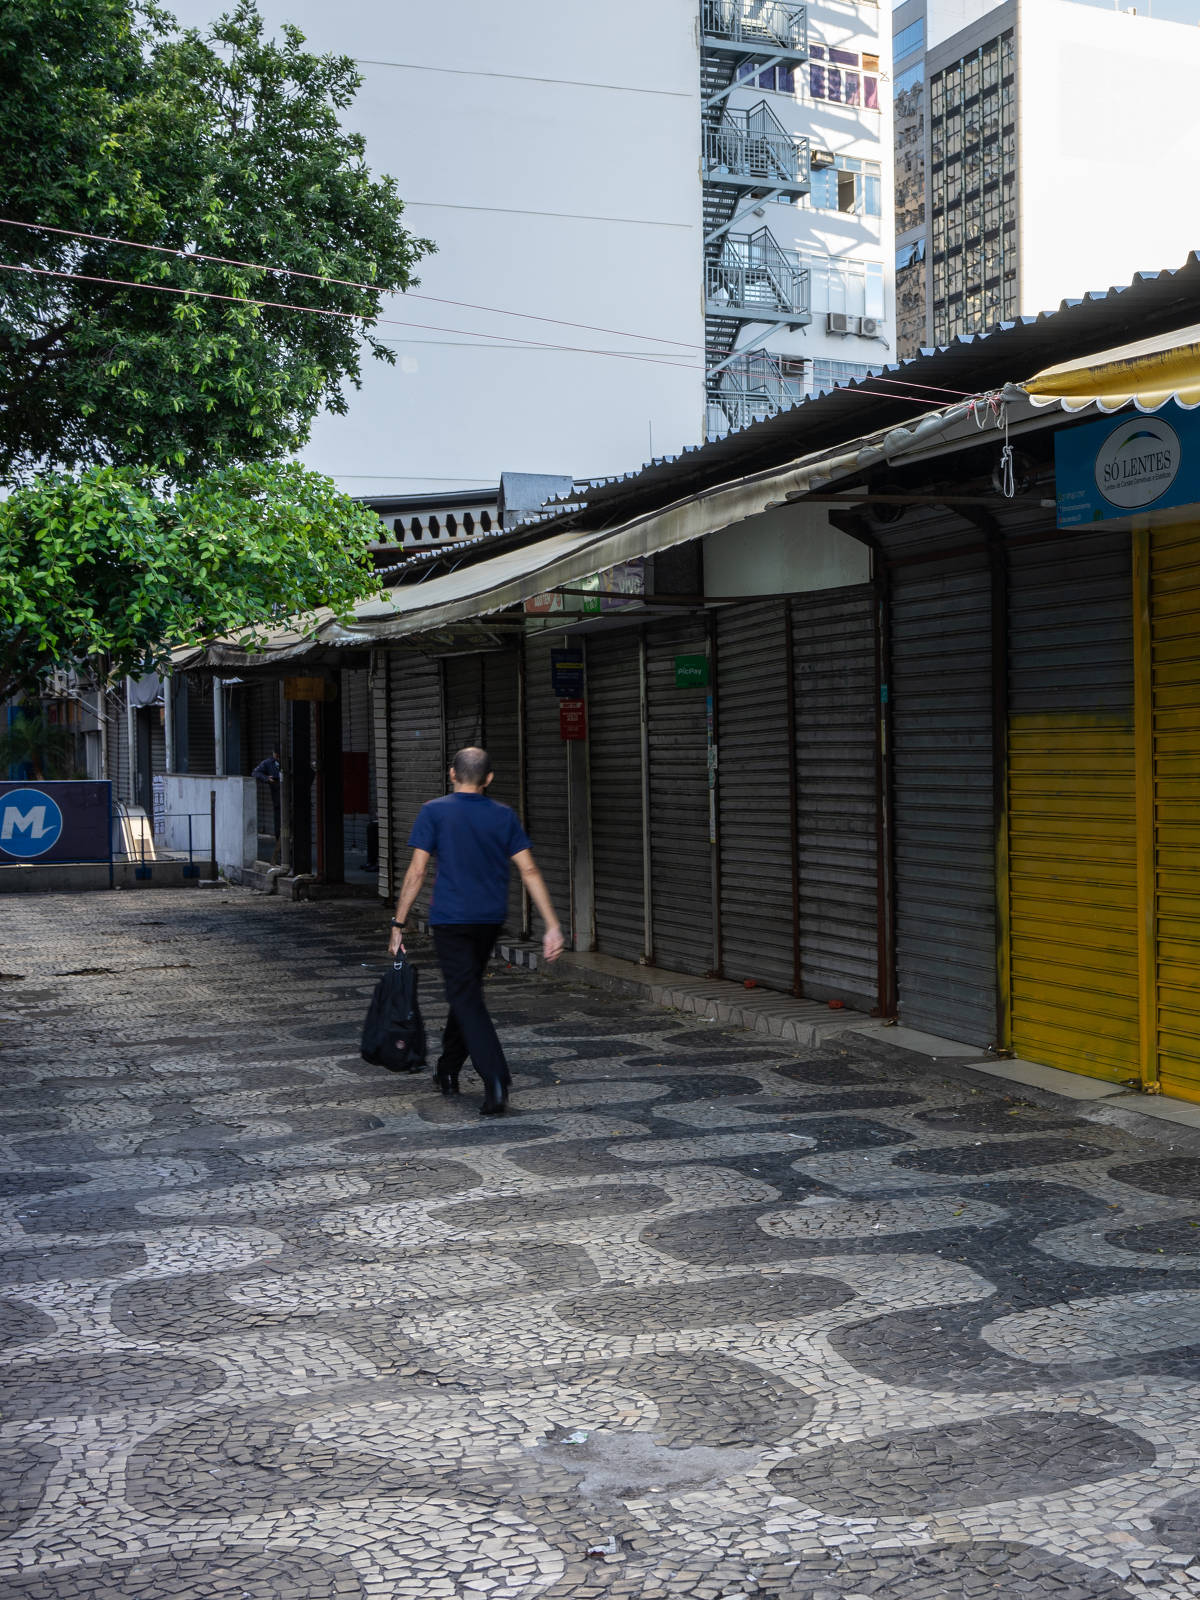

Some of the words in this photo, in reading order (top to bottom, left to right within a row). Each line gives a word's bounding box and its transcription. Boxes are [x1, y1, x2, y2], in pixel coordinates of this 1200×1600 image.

[1104, 456, 1120, 482] SÓ
[1122, 449, 1172, 479] LENTES
[0, 805, 57, 840] M
